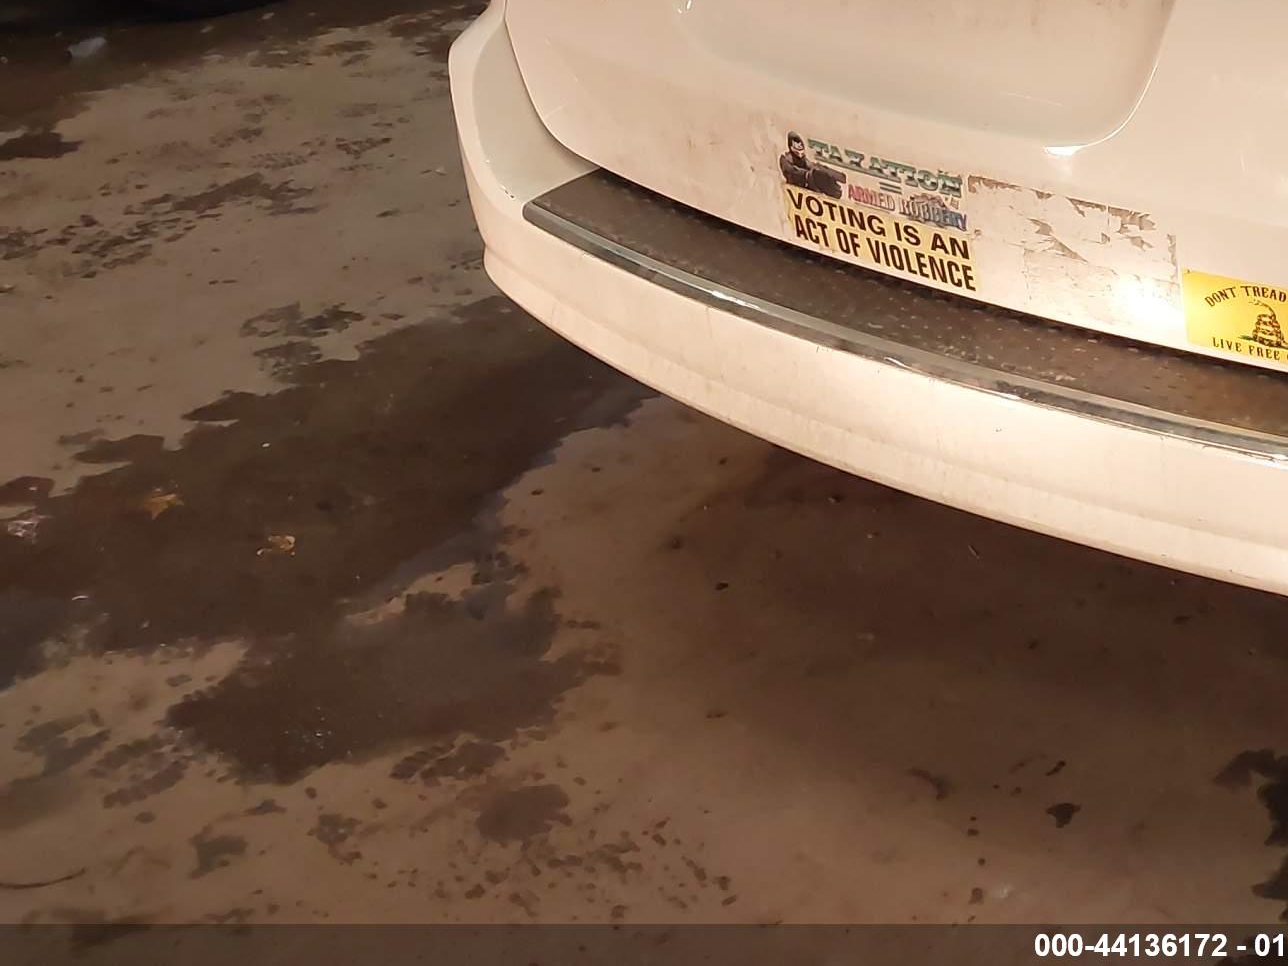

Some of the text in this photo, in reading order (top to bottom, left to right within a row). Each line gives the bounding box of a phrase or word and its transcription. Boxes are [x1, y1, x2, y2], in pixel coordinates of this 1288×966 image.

[807, 138, 962, 197] TAXATION
[787, 189, 970, 259] VOTING IS AN
[849, 185, 967, 231] ARMED ROBBERY
[795, 215, 976, 291] ACT OF VIOLENCE
[1240, 285, 1287, 302] TREAD
[1212, 337, 1242, 353] LIVE
[1248, 345, 1280, 361] FREE
